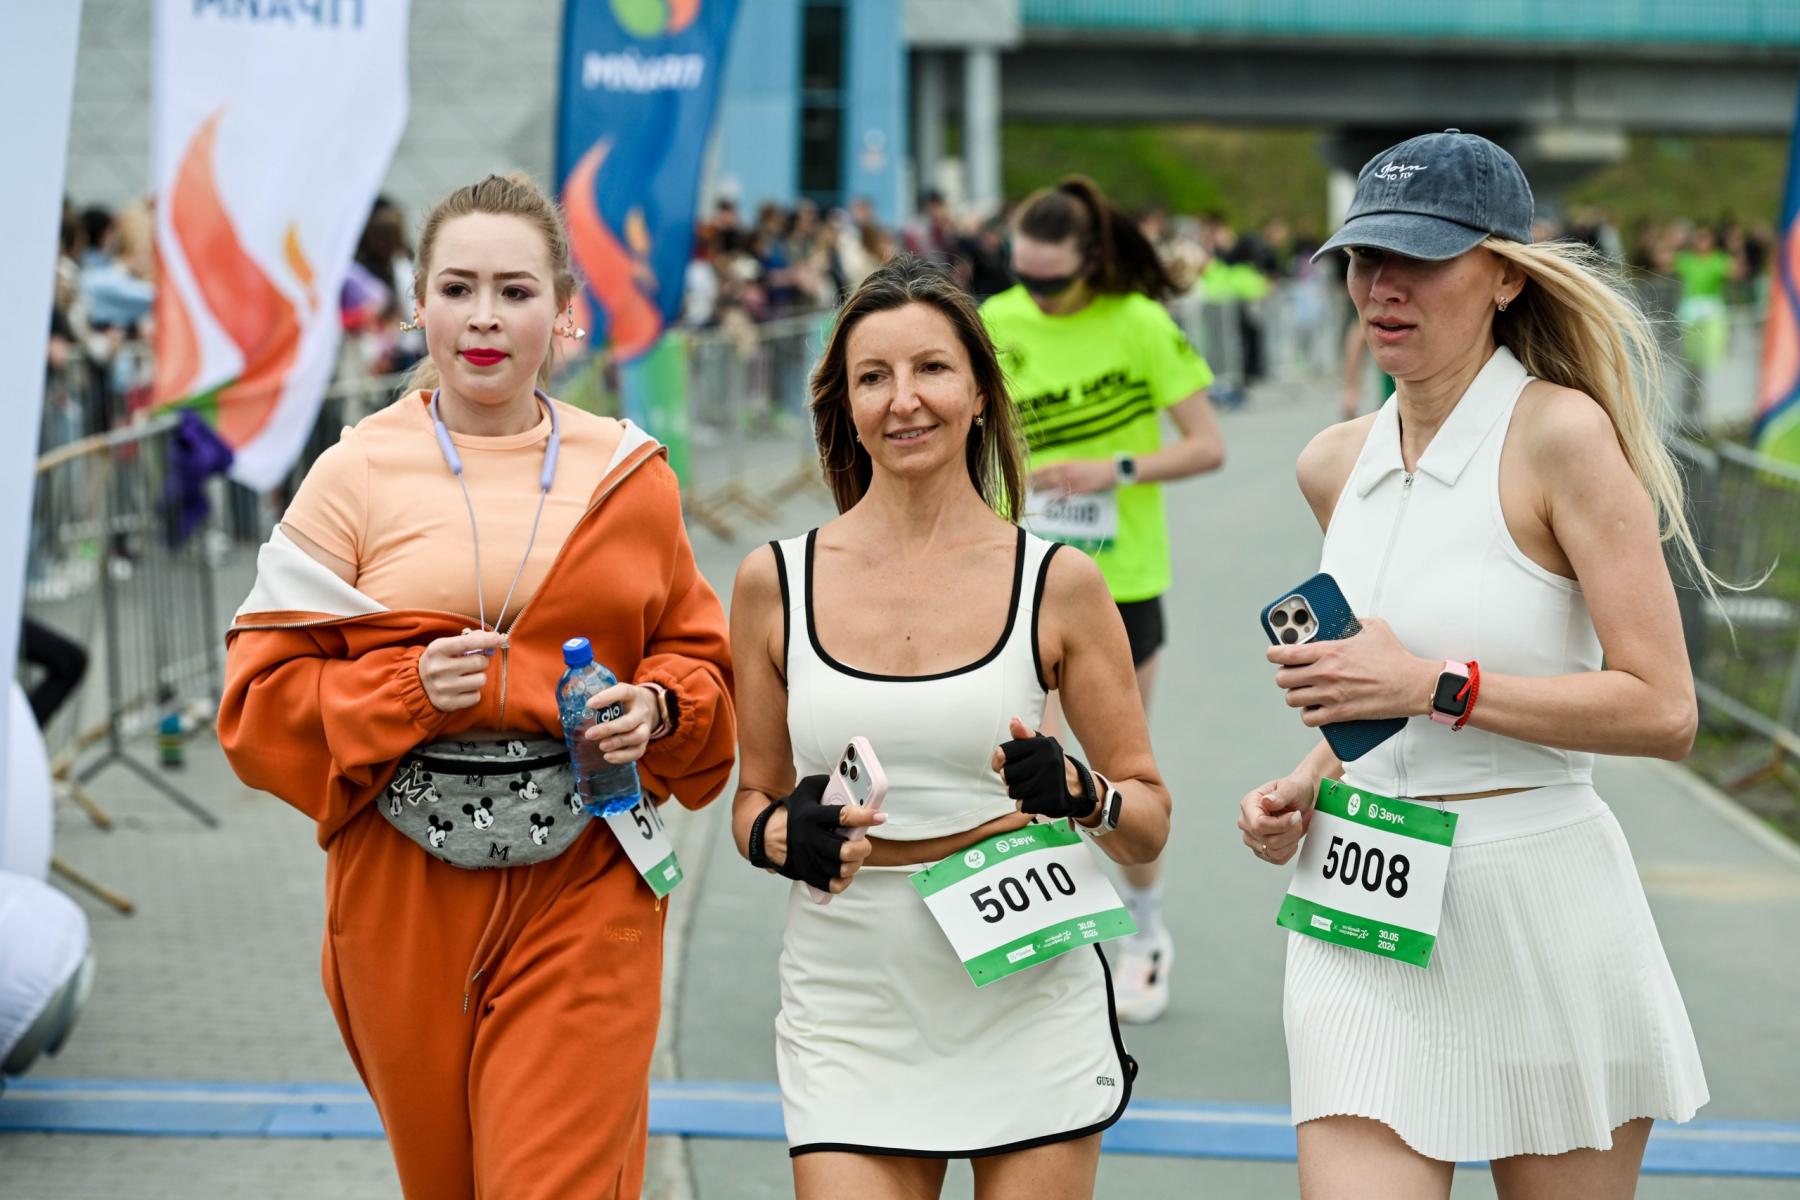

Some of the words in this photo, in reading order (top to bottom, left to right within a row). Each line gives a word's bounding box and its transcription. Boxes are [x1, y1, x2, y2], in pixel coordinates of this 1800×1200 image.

[391, 768, 435, 806] M
[1379, 808, 1405, 824] Звук
[1008, 835, 1035, 848] Звук
[489, 842, 510, 861] M
[1322, 835, 1410, 898] 5008
[970, 862, 1076, 923] 5010
[1378, 930, 1399, 941] 30.05
[1377, 940, 1396, 952] 2026
